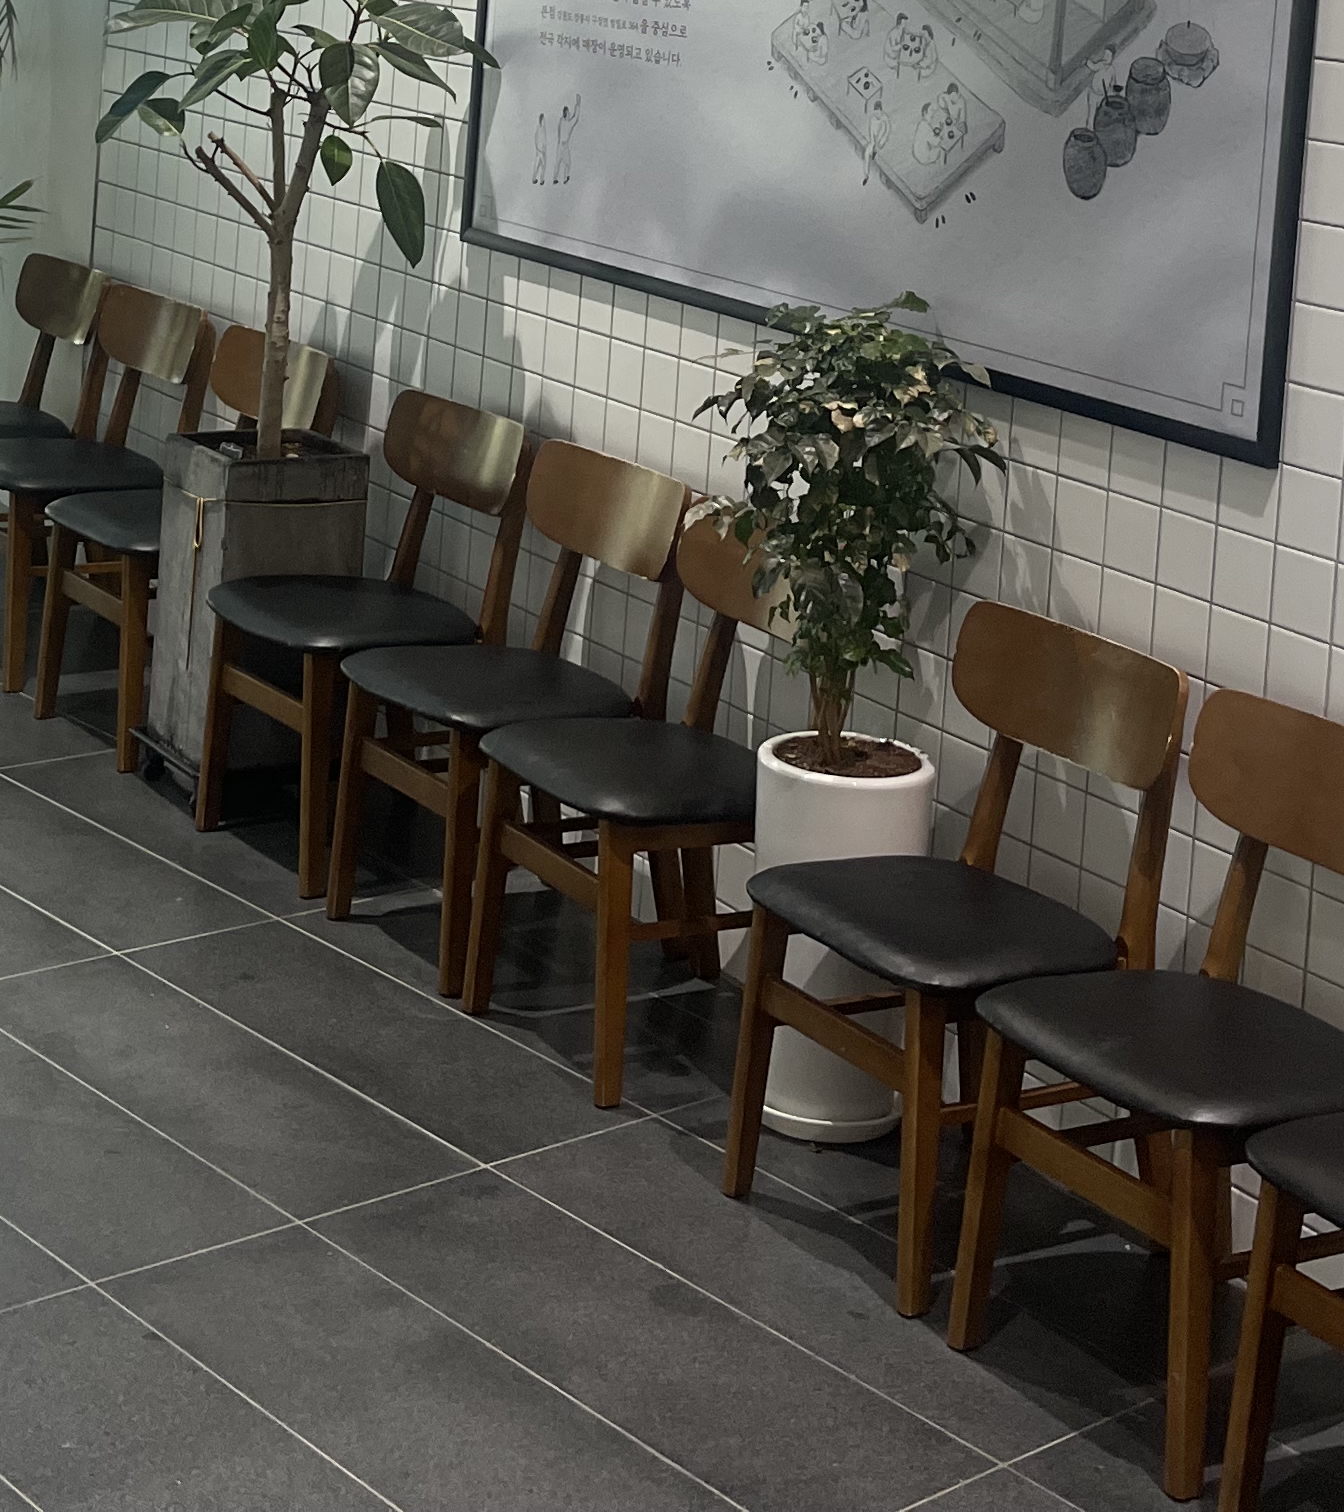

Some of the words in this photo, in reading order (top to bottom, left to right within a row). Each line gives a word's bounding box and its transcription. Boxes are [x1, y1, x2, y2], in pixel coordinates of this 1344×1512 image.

[541, 5, 556, 19] 본점
[651, 21, 688, 38] 중심으로
[539, 32, 555, 45] 전국
[556, 33, 580, 51] 각지에
[608, 42, 642, 59] 운영되고
